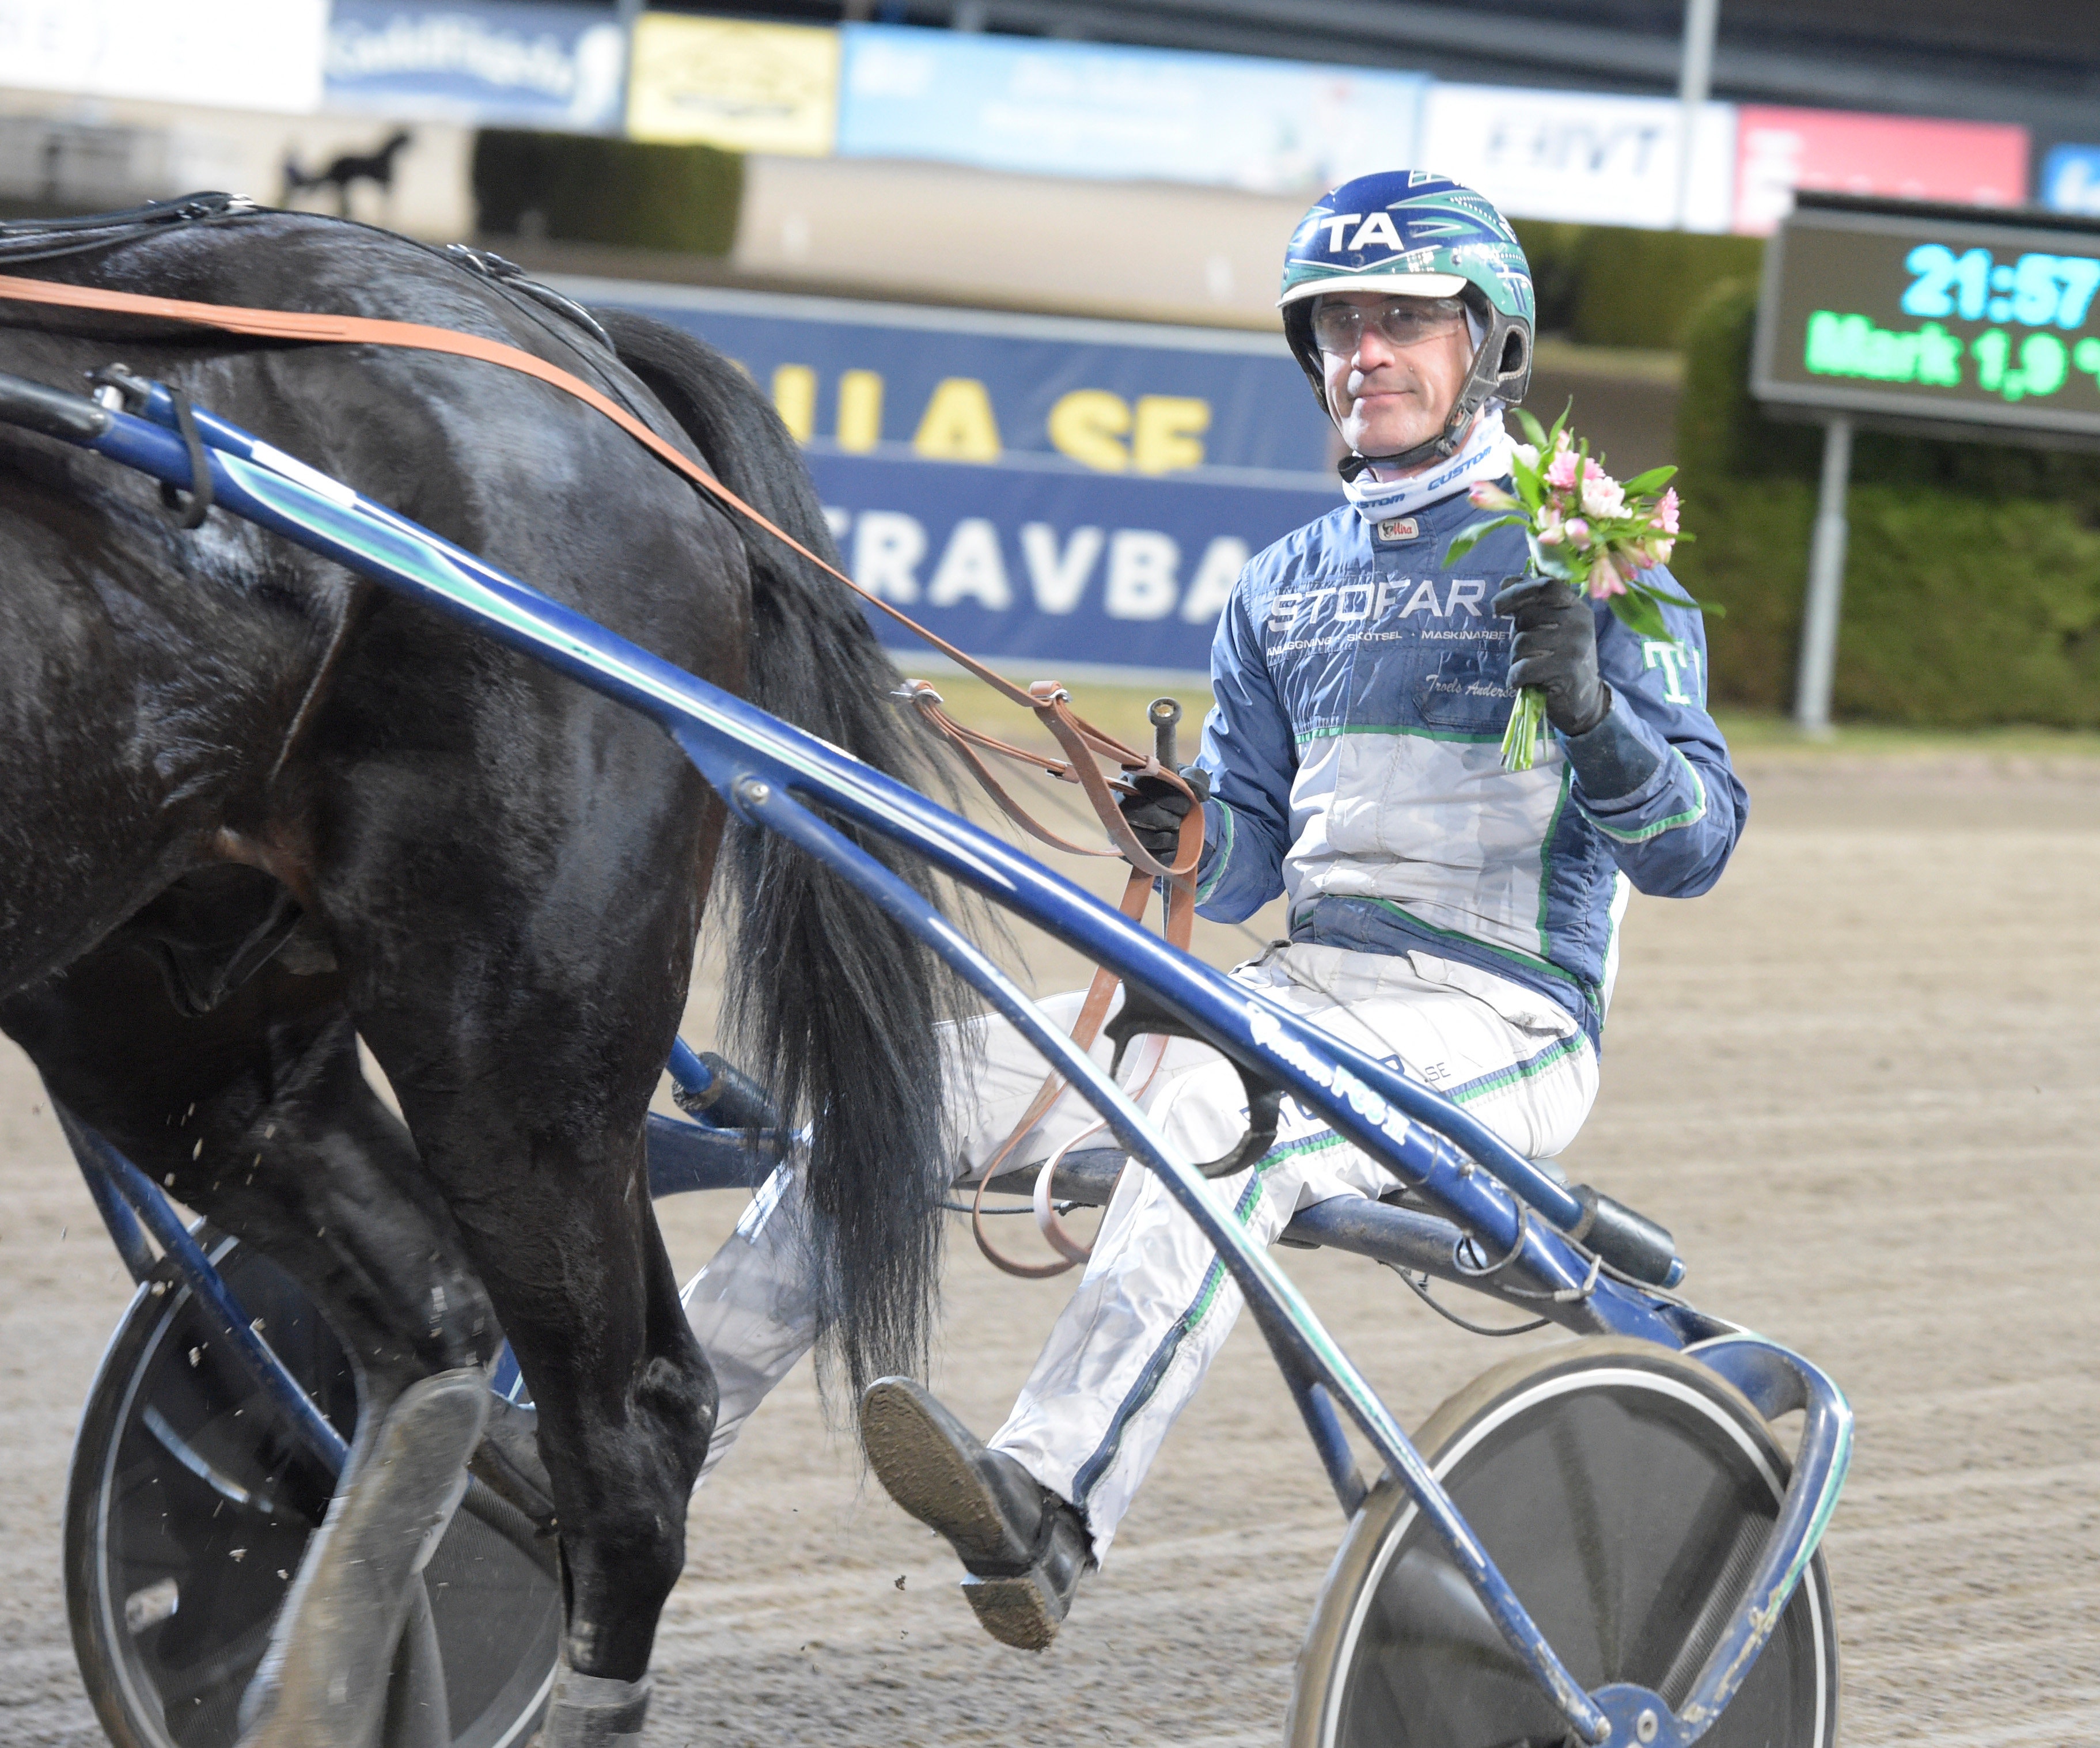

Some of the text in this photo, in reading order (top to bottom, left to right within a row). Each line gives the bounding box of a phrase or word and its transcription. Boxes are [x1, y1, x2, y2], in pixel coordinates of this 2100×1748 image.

[1320, 212, 1405, 253] TA
[1901, 243, 2100, 330] 21:57
[1805, 309, 1964, 388] Mark
[1427, 445, 1492, 491] CUSTOM
[820, 505, 1256, 625] RAVBA
[1268, 579, 1489, 632] STOFAR
[1426, 674, 1462, 693] Troels
